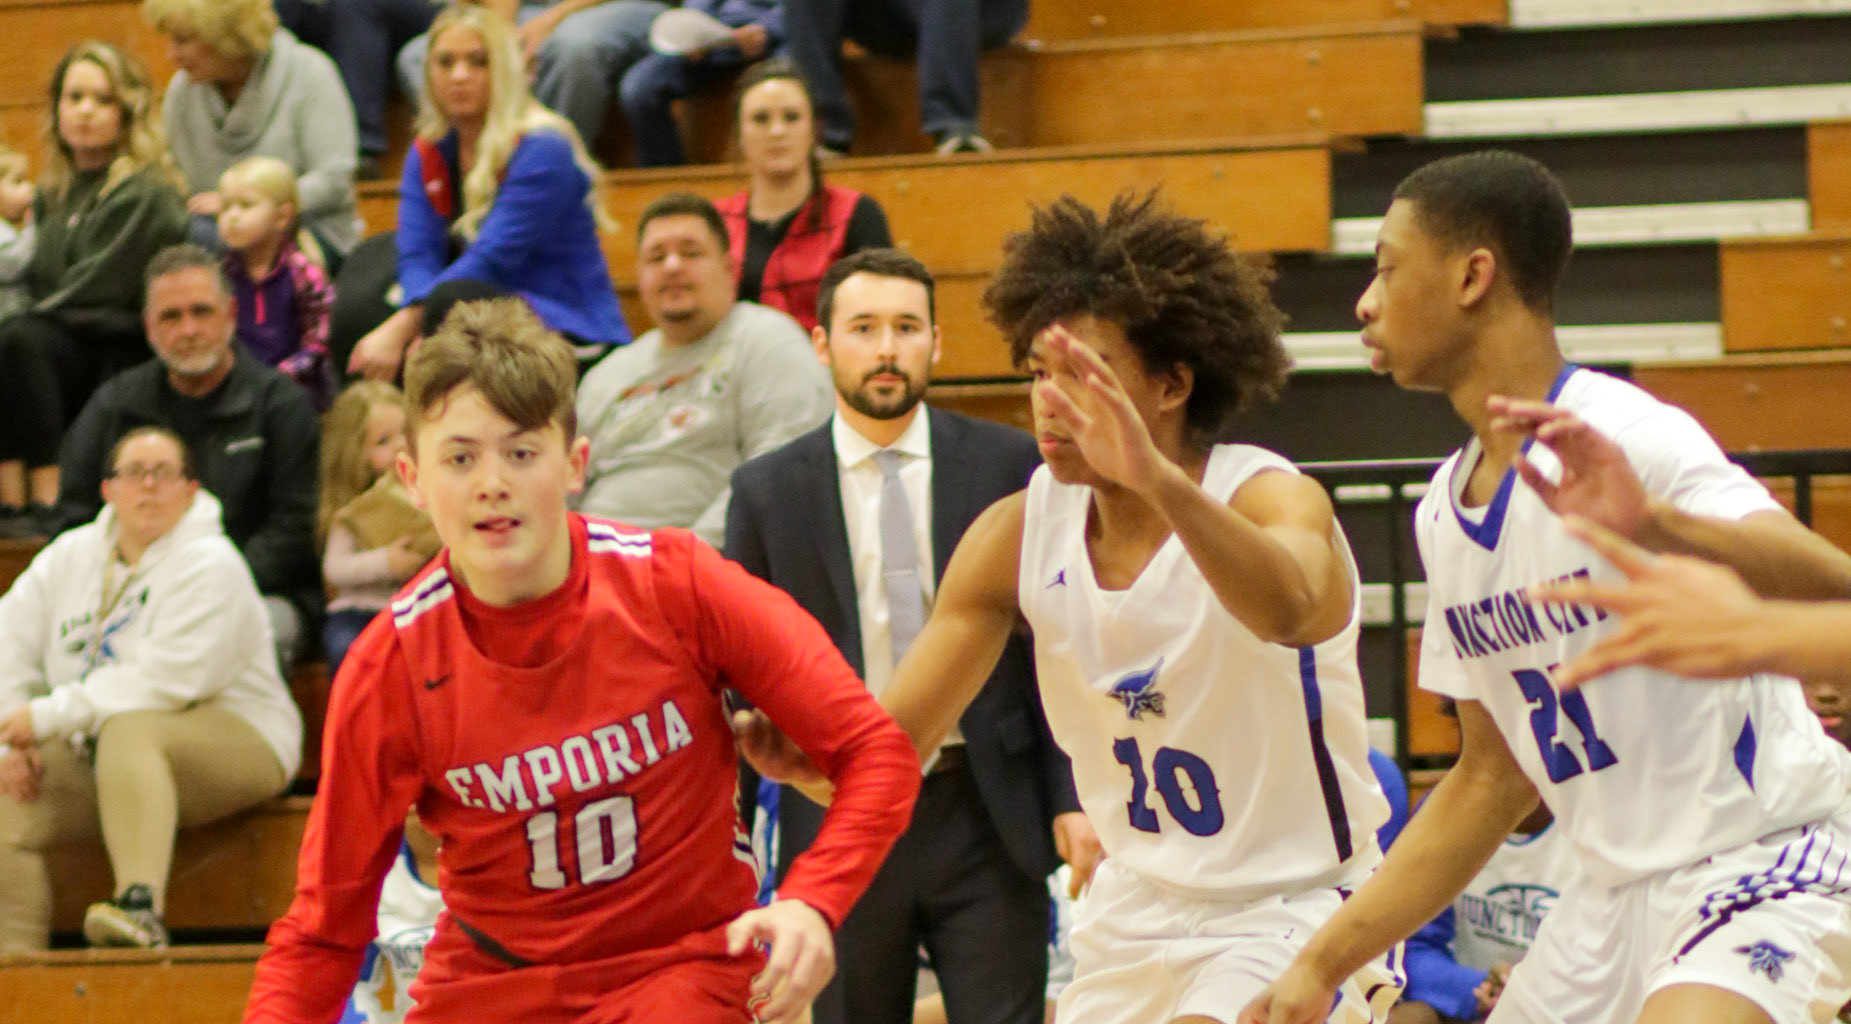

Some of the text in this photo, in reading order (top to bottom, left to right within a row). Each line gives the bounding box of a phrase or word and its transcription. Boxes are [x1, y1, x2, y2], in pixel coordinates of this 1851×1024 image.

[444, 700, 694, 813] EMPORIA
[1510, 662, 1619, 784] 21
[1112, 736, 1225, 837] 10
[525, 794, 639, 890] 10
